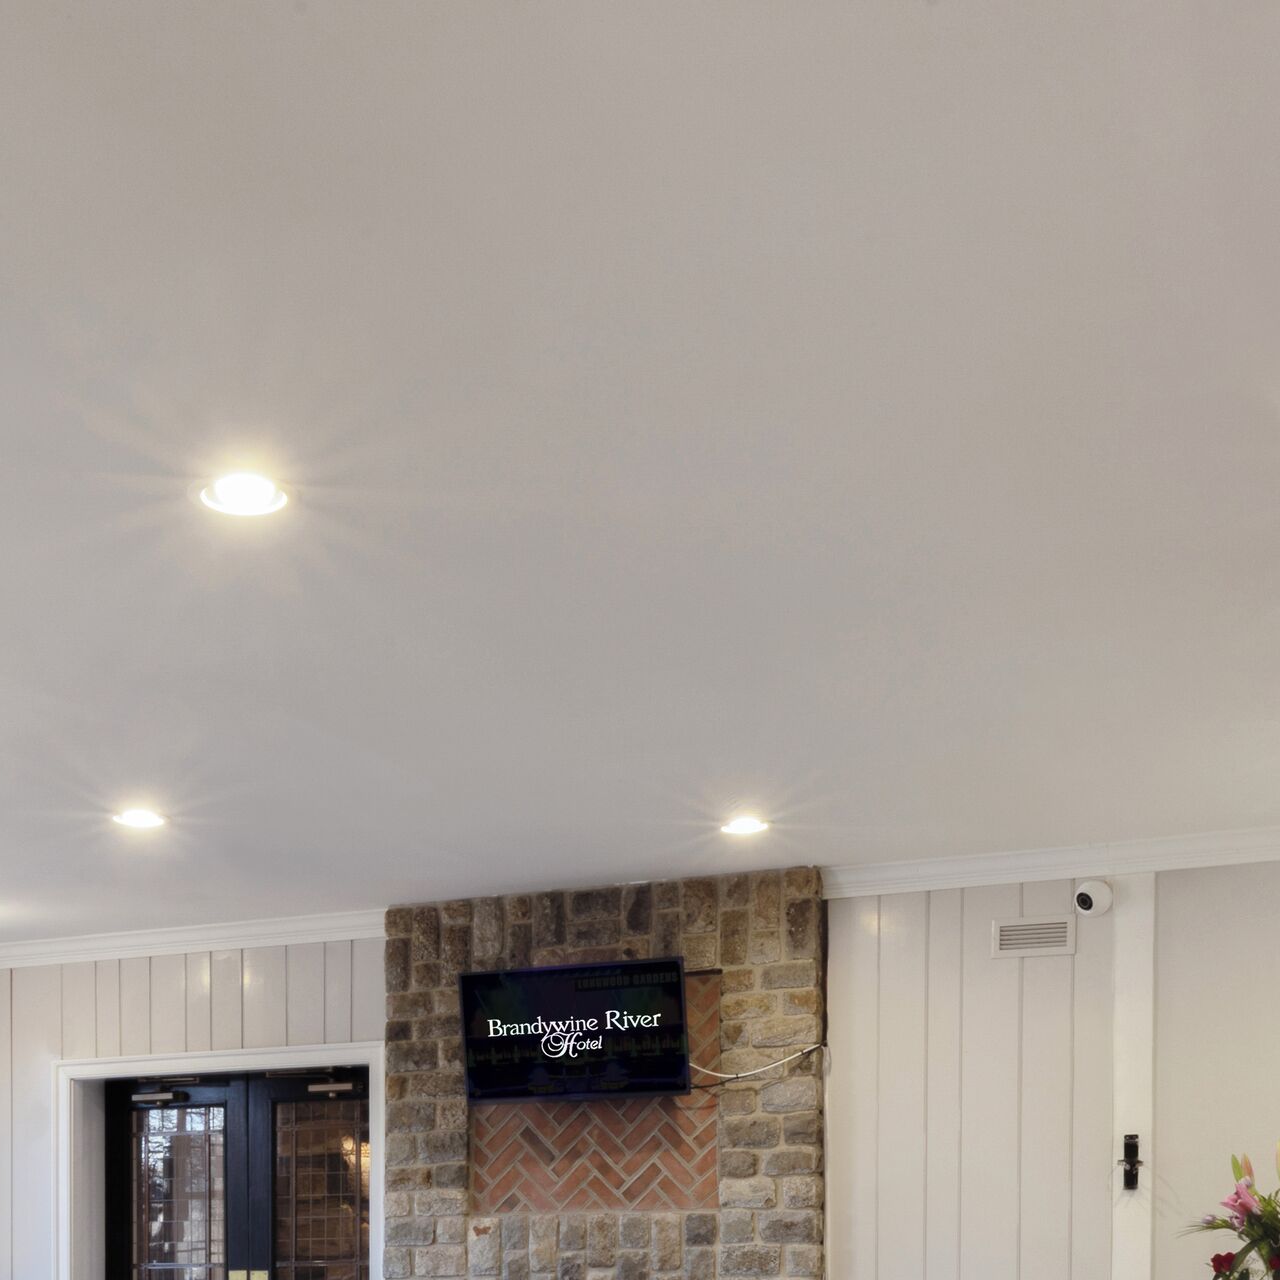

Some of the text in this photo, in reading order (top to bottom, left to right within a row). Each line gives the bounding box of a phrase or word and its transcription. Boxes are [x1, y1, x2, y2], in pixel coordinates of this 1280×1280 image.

[487, 1010, 662, 1041] Brandywine River
[541, 1032, 603, 1058] Hotel
